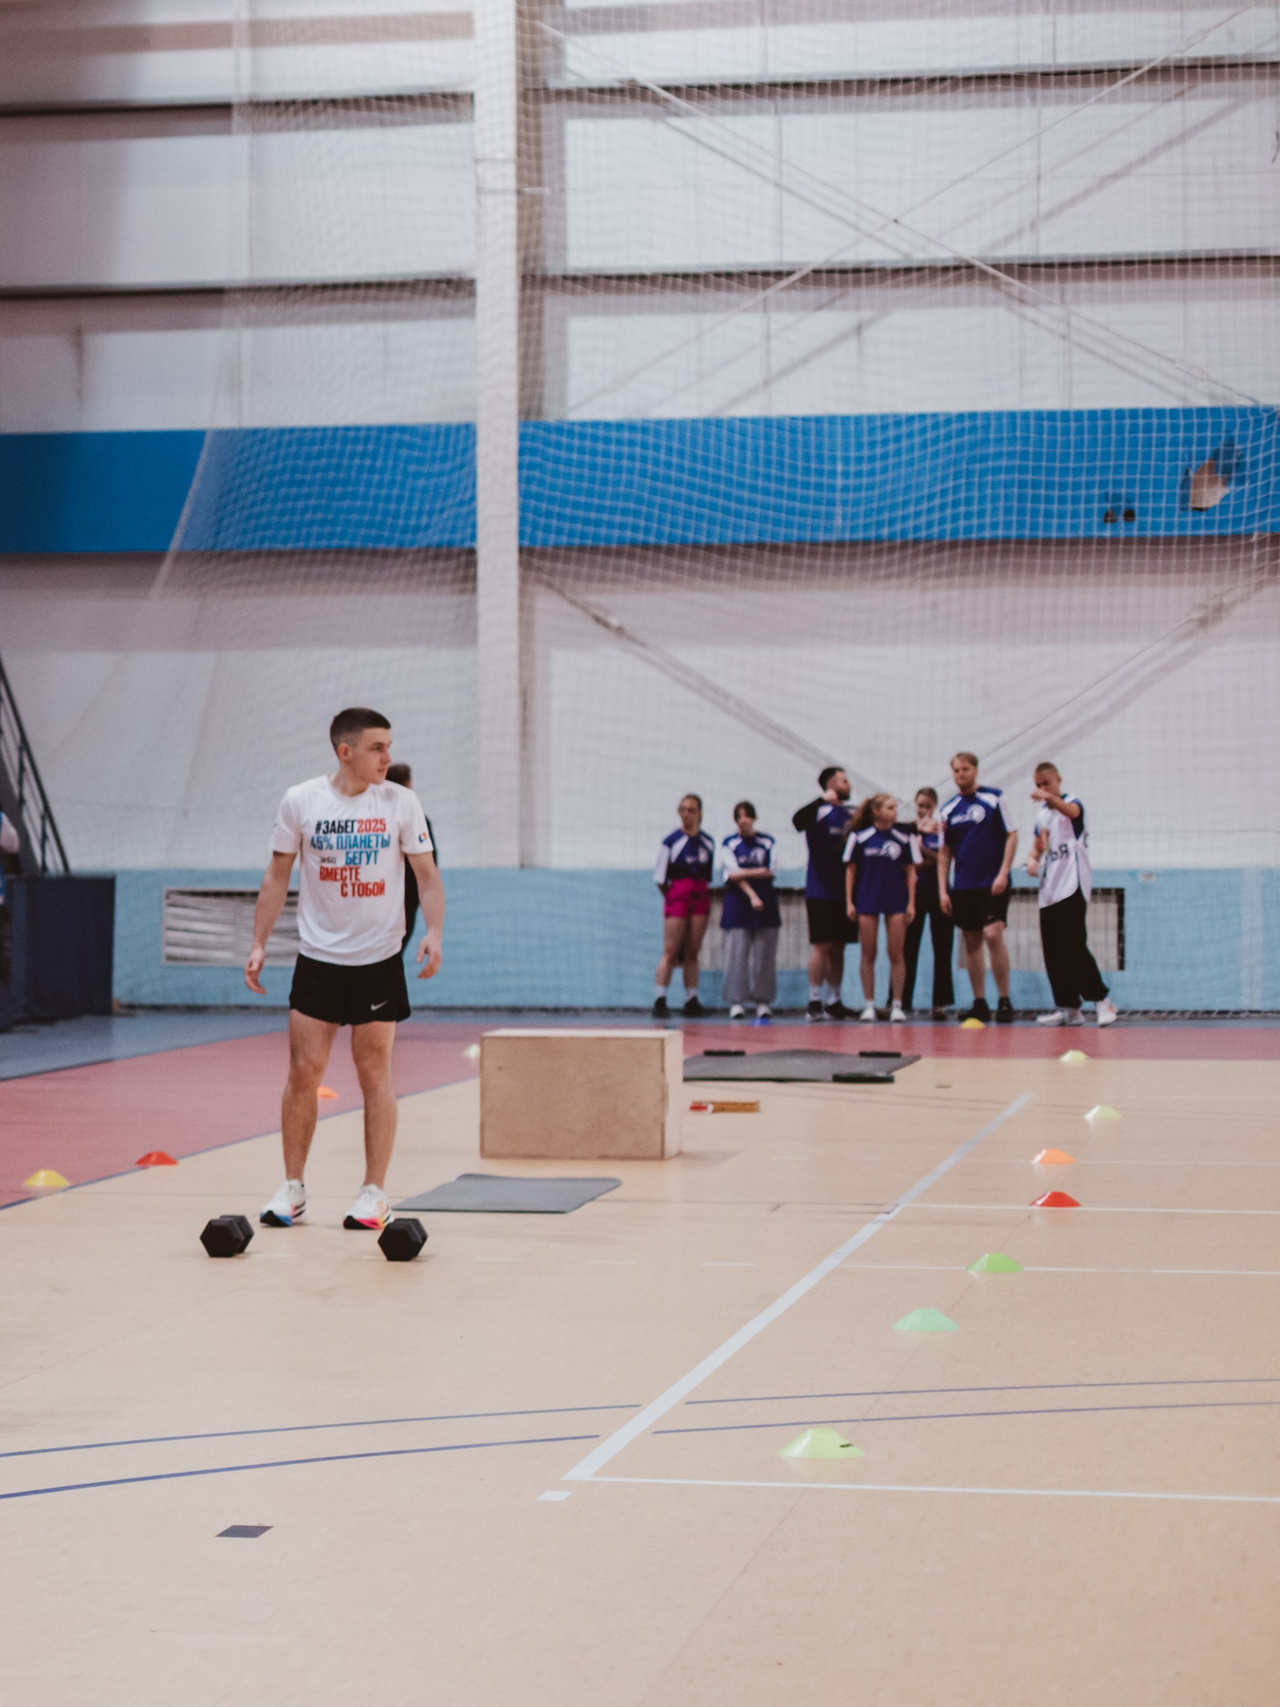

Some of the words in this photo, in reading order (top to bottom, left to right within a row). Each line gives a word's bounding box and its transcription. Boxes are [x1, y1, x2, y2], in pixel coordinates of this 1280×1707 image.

[315, 818, 386, 834] #ЗАБЕГ2025
[336, 833, 391, 850] ПЛАНЕТЫ
[345, 850, 379, 866] БЕГУТ
[319, 865, 361, 882] ВМЕСТЕ
[340, 882, 348, 898] С
[351, 878, 386, 898] ТОБОЙ
